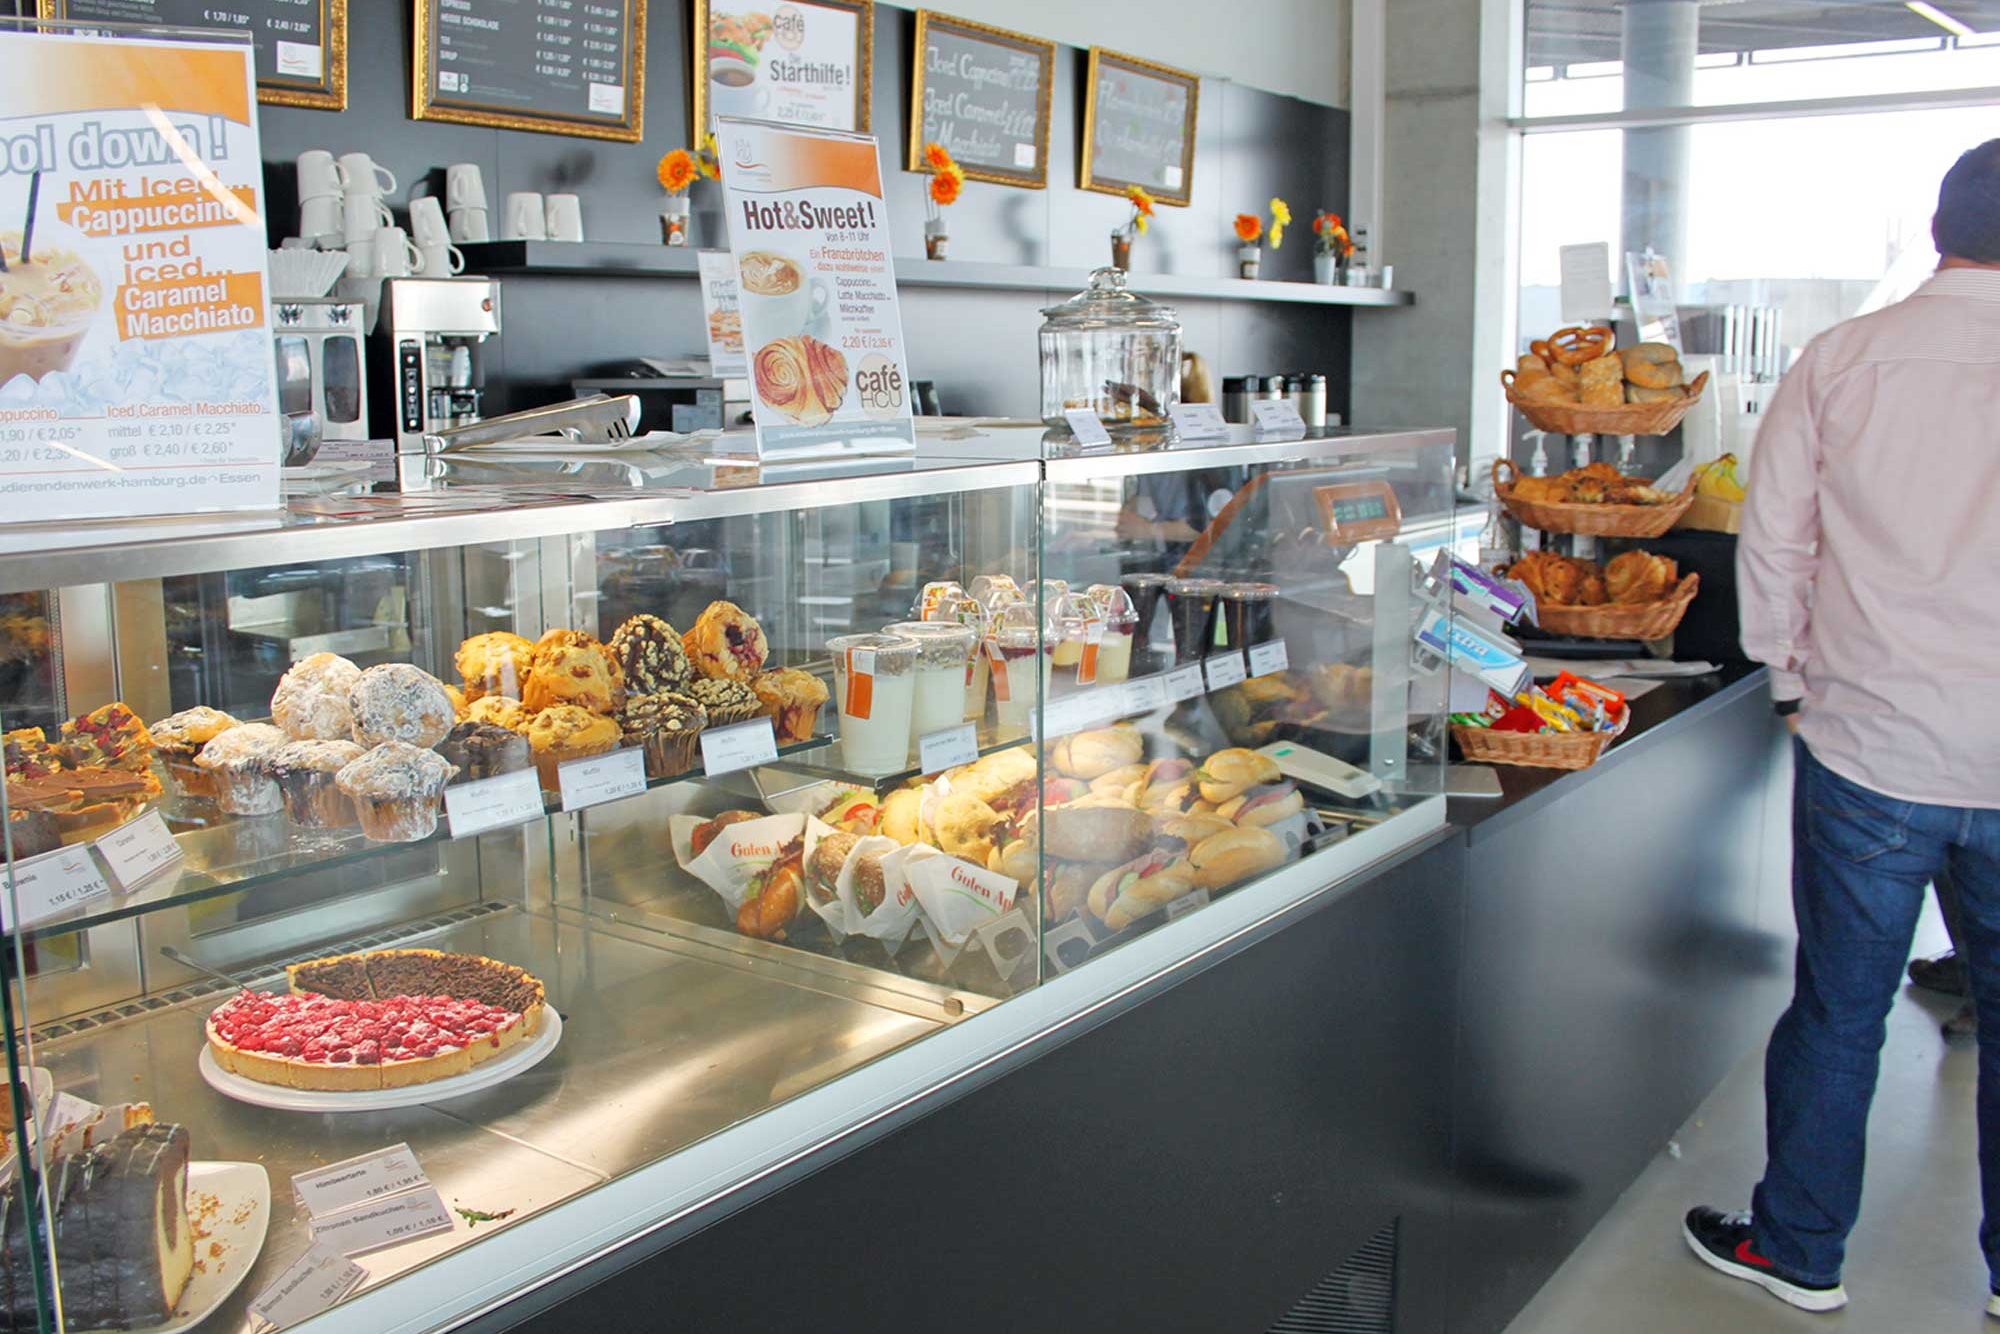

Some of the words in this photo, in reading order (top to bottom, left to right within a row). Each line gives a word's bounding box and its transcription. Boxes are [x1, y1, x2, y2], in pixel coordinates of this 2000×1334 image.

[69, 176, 127, 203] Mit
[742, 200, 877, 231] Hot&Sweet!
[122, 235, 191, 263] und
[821, 246, 885, 262] Franzbrötchen
[124, 279, 227, 312] Caramel
[127, 302, 255, 338] Macchiato
[855, 363, 902, 392] café
[860, 389, 903, 409] HCU
[107, 403, 135, 418] Iced
[139, 402, 193, 418] Caramel
[196, 401, 261, 416] Macchiato
[37, 427, 46, 441] €
[108, 425, 142, 438] mittel
[148, 424, 157, 437] €
[160, 423, 183, 438] 2,10
[194, 422, 201, 436] €
[32, 447, 41, 461] €
[143, 444, 151, 458] €
[154, 443, 179, 458] 2,40
[191, 441, 199, 455] €
[219, 472, 261, 485] Essen
[730, 842, 772, 858] Guten
[951, 865, 991, 899] Guten
